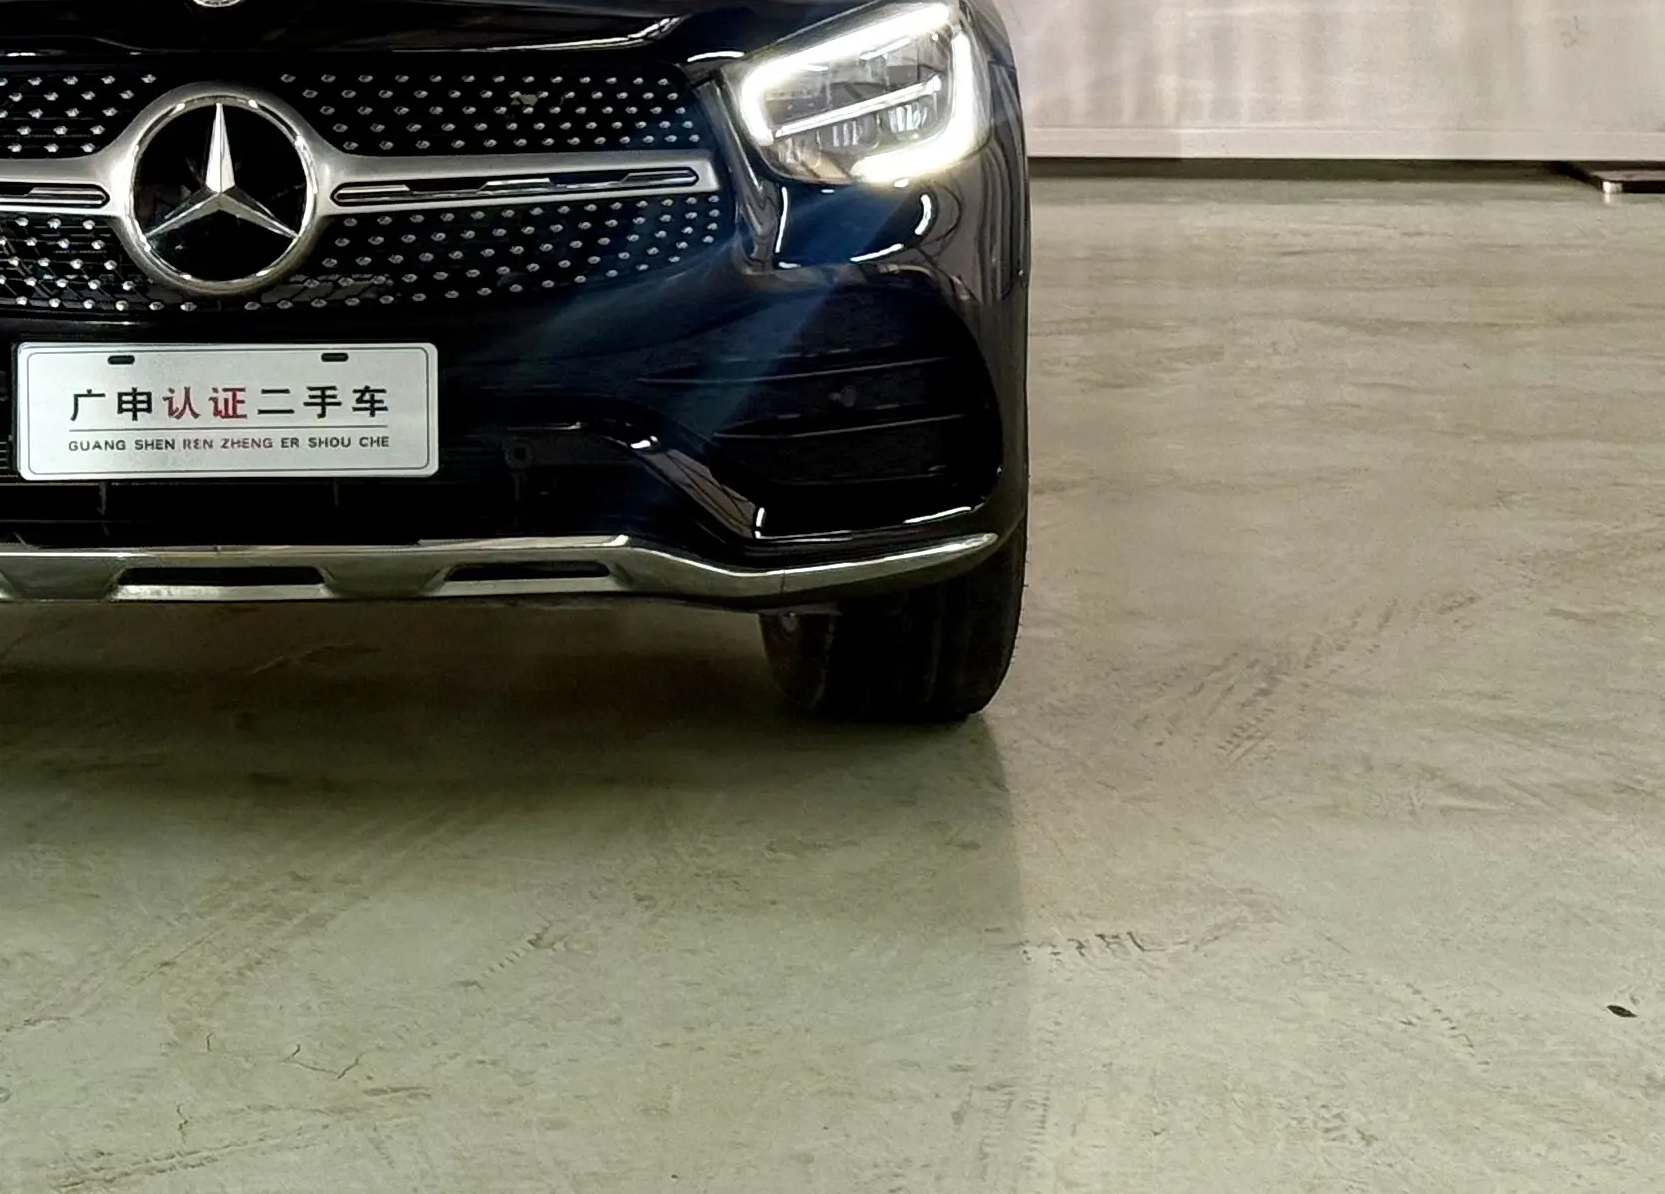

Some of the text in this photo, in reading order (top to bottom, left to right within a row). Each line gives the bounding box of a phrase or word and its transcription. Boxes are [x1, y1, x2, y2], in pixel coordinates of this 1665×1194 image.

[69, 384, 390, 422] 广申认证二手车
[68, 435, 391, 452] GUANG SHEN REN ZHENG ER SHOU CHE
